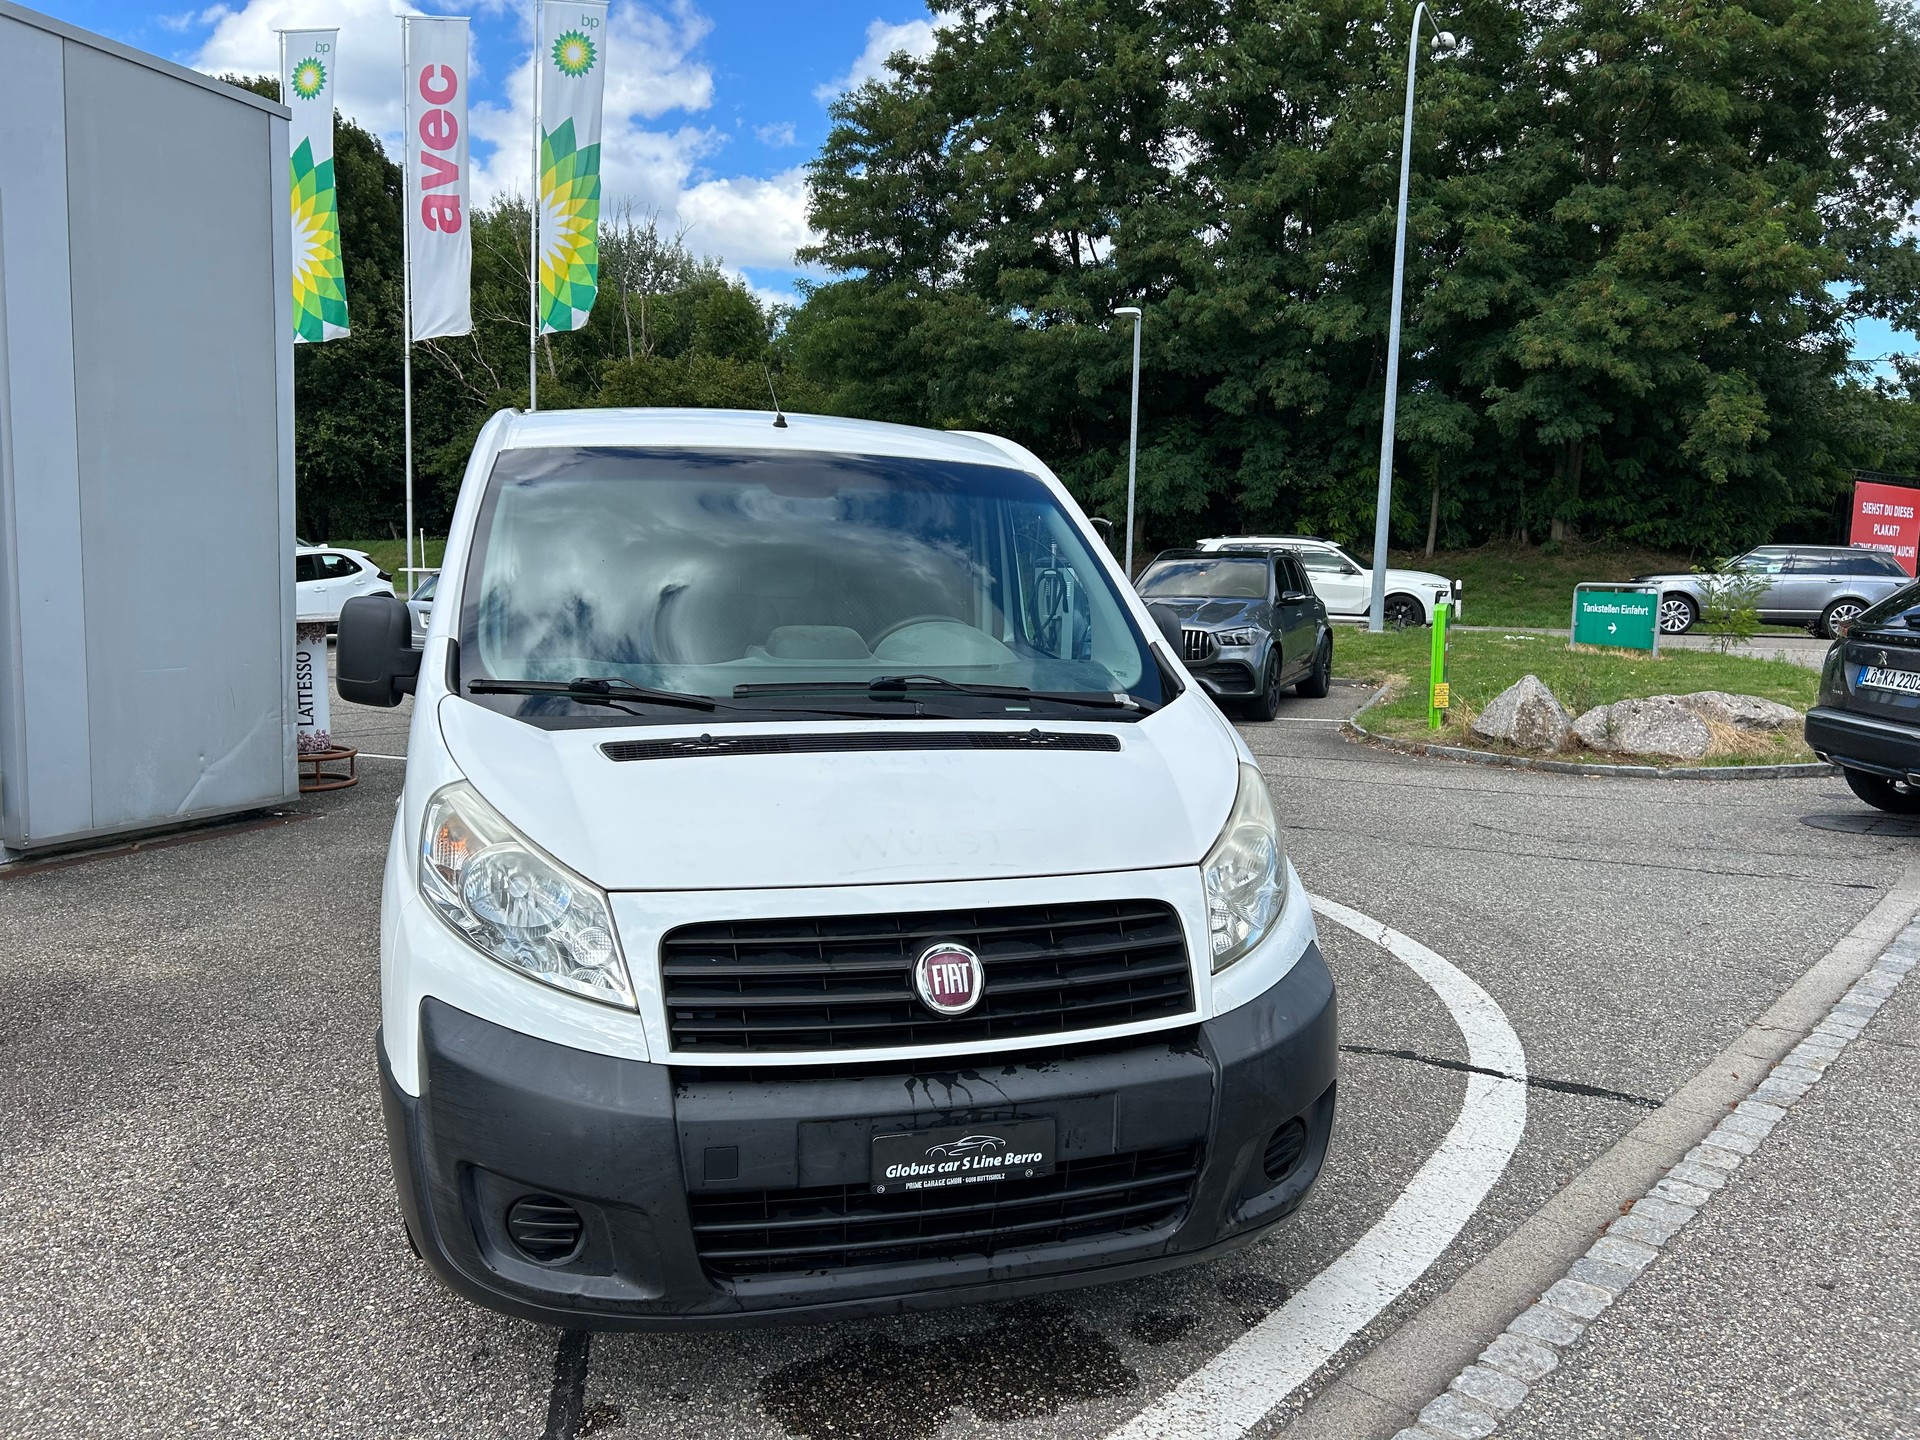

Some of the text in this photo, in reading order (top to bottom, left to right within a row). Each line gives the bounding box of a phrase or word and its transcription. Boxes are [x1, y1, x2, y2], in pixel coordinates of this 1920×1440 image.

[581, 14, 600, 30] bp
[315, 41, 330, 55] bp
[419, 64, 463, 234] avec
[1862, 502, 1914, 518] SIEHST DU DIESES
[1873, 523, 1900, 536] PLAKAT?
[1583, 602, 1649, 616] Tankstellen Einfahrt
[296, 651, 314, 726] LATTESSO
[932, 963, 969, 995] FIAT
[886, 1152, 1043, 1179] Globus car S Line Berro
[923, 1179, 946, 1188] GARAGE
